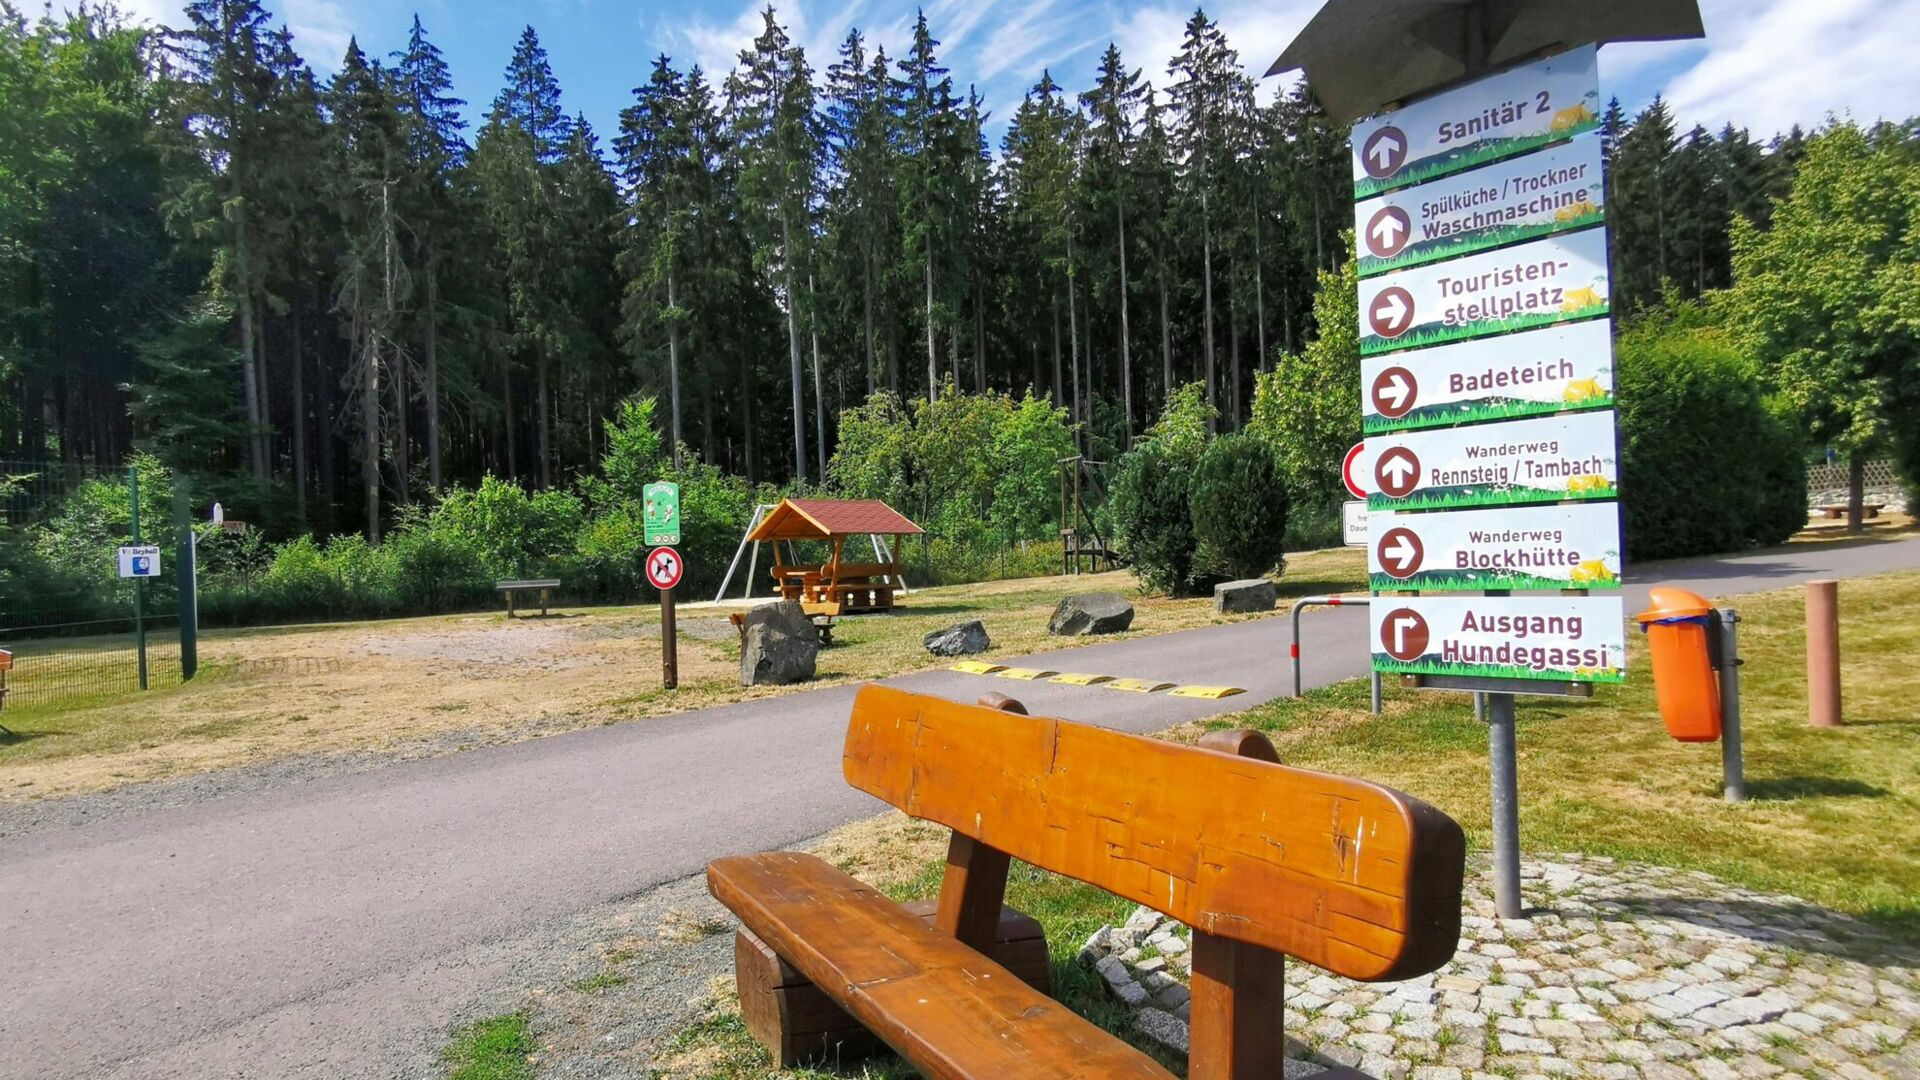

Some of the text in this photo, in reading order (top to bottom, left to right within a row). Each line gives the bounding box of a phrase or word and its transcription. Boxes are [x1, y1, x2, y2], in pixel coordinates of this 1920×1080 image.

[1438, 90, 1550, 144] Sanitär 2
[1421, 163, 1587, 219] Spülküche / Trockner
[1423, 188, 1588, 239] Waschmaschine
[1438, 261, 1568, 298] Touristen-
[1444, 287, 1564, 325] stellplatz
[1449, 358, 1574, 394] Badeteich
[1465, 440, 1559, 459] Wanderweg
[1431, 463, 1508, 486] Rennsteig
[1524, 455, 1602, 479] Tambach
[1469, 528, 1563, 544] Wanderweg
[1456, 549, 1581, 569] Blockhütte
[1461, 610, 1583, 640] Ausgang
[1443, 639, 1608, 671] Hundegassi
